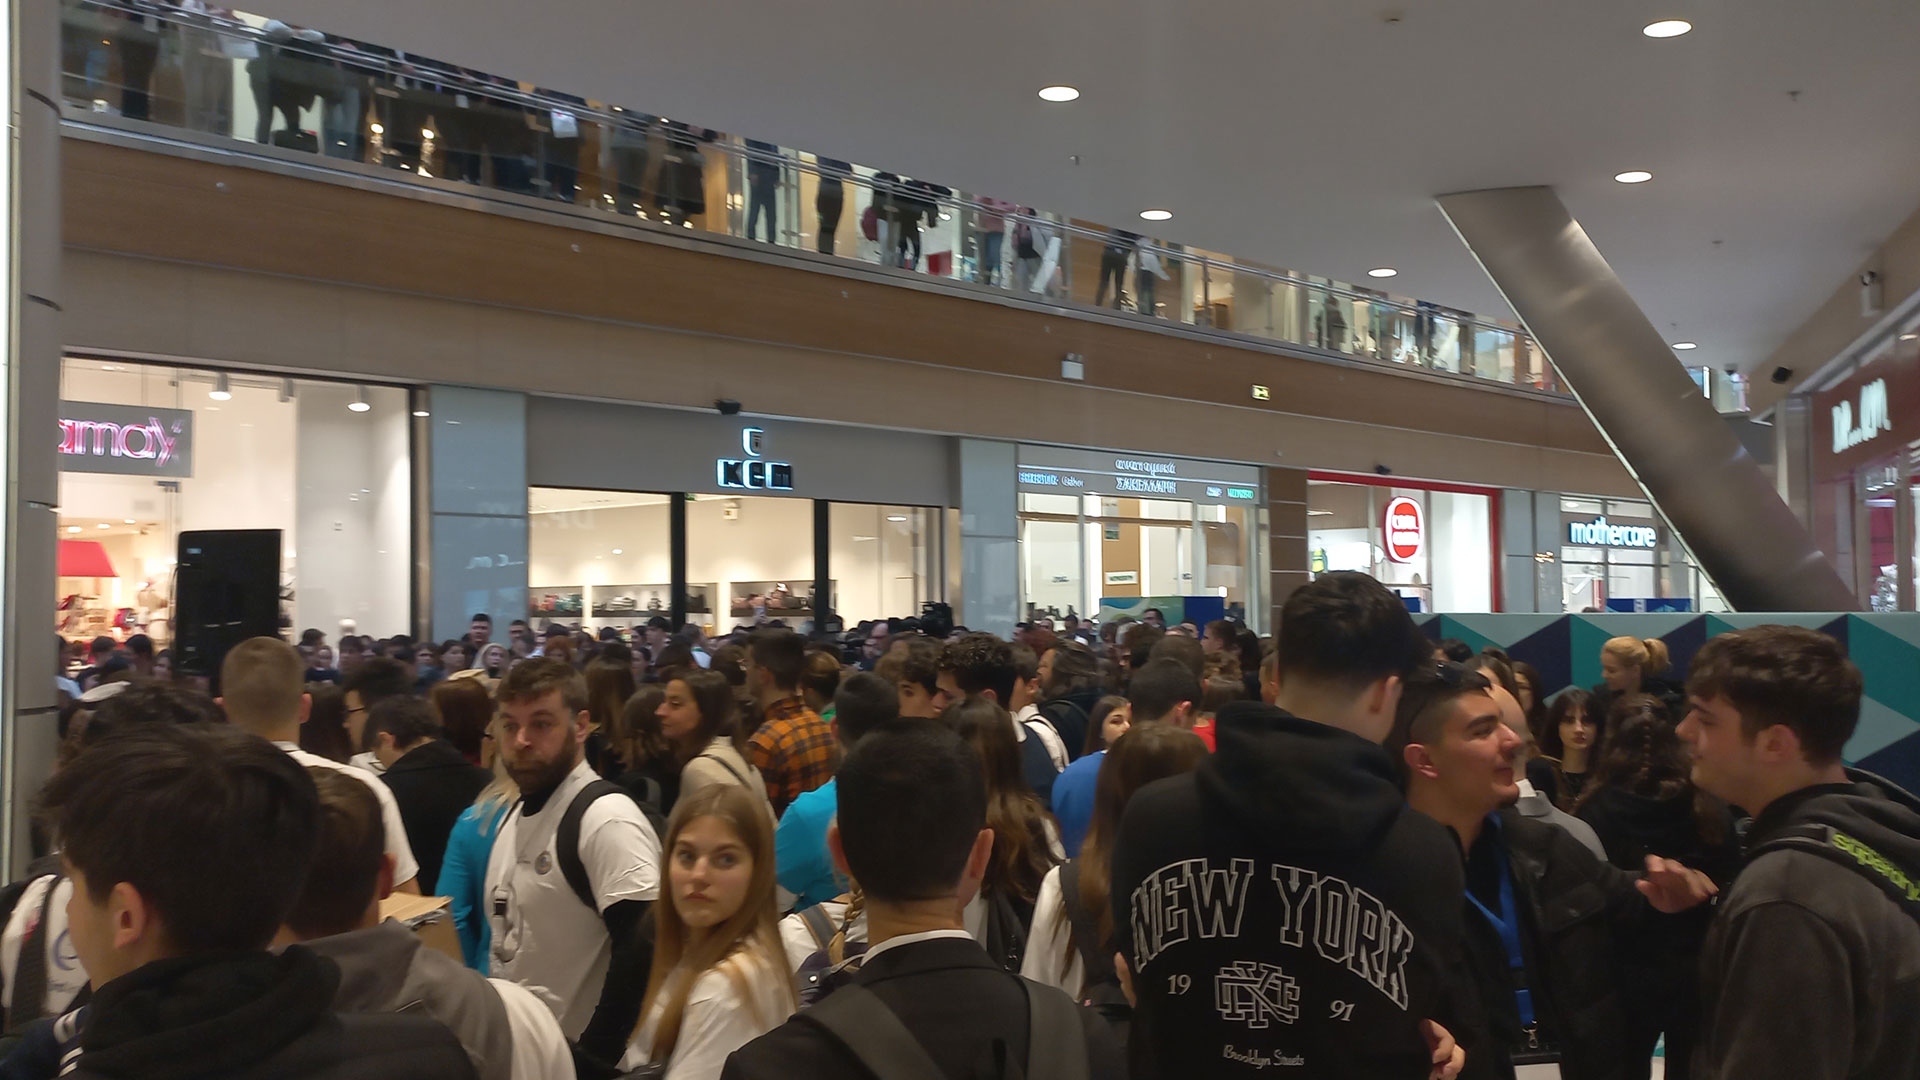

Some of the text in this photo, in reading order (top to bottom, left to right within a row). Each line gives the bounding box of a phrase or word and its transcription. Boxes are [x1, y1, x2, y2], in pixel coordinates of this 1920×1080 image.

[1569, 515, 1657, 548] mothercare
[1130, 857, 1414, 1011] NEW YORK
[1167, 974, 1355, 1022] 19 91
